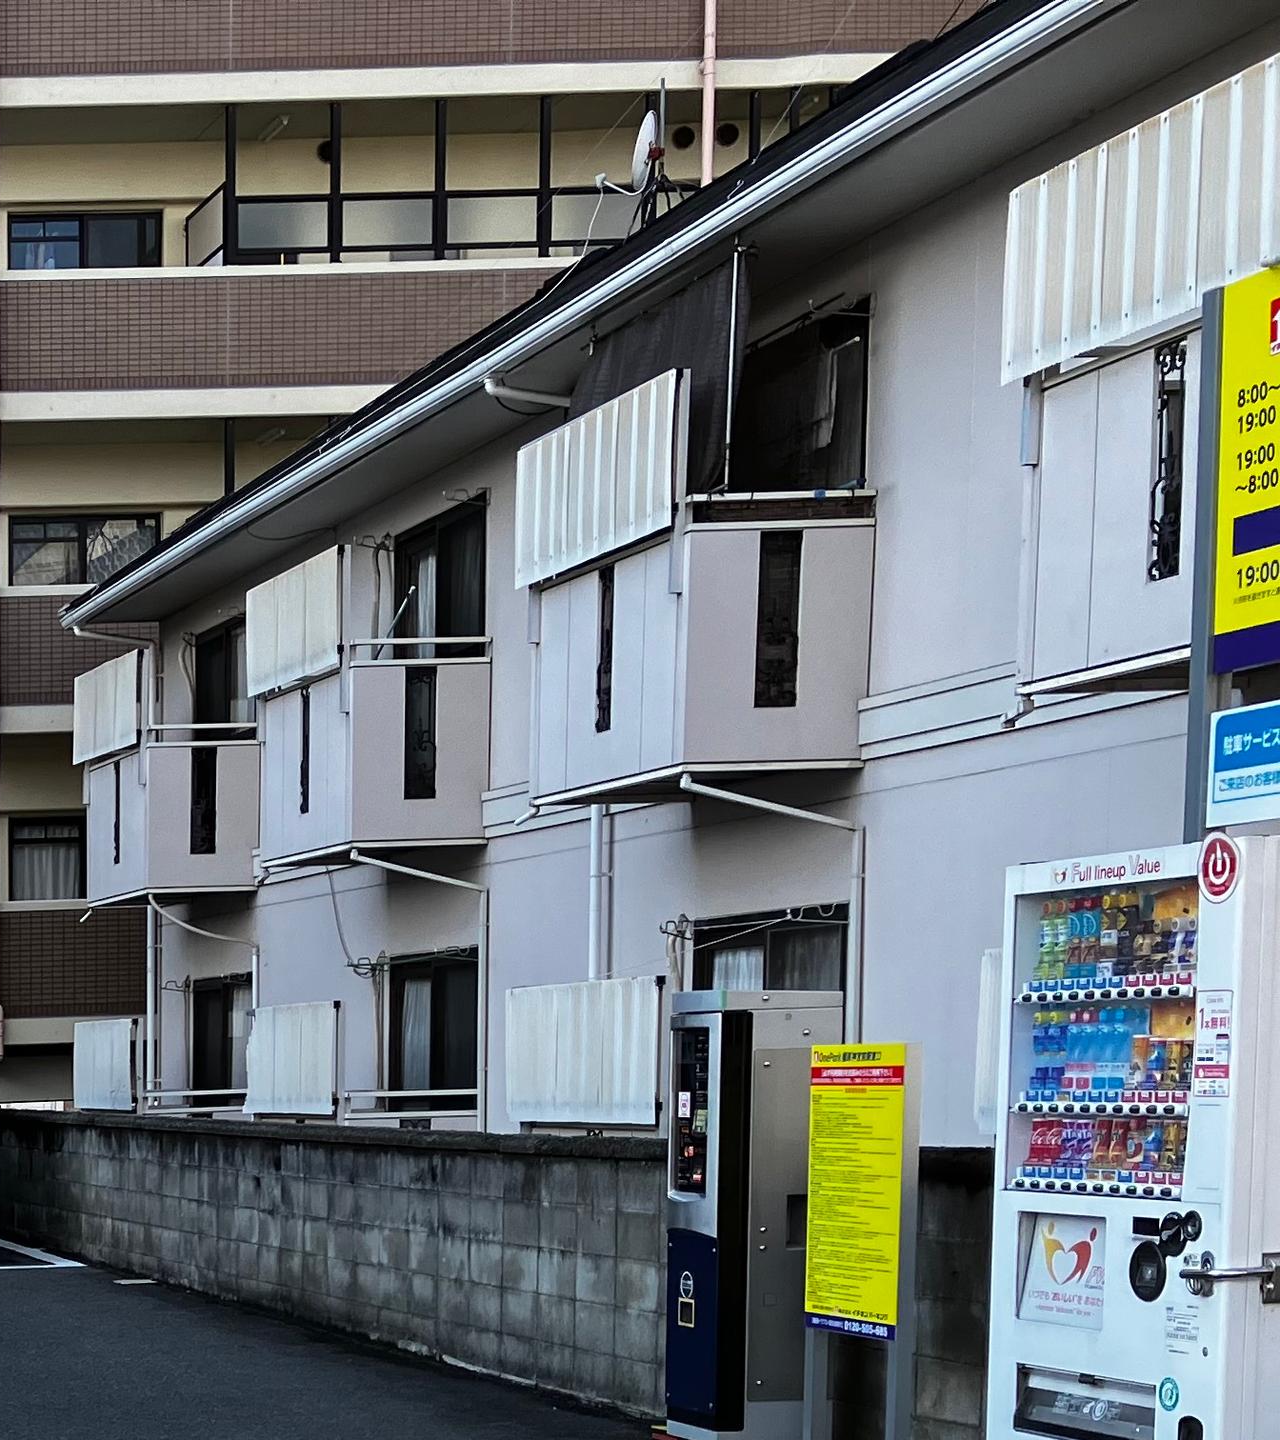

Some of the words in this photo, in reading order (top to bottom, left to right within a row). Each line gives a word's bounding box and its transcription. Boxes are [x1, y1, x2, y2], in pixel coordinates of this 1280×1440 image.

[1237, 404, 1276, 434] 19:00
[1236, 442, 1276, 471] 19:00
[1236, 559, 1280, 589] 19:00
[1222, 728, 1280, 756] 駐車サービス
[1071, 862, 1092, 883] Full
[1094, 864, 1126, 881] lineup
[1129, 854, 1161, 876] Value
